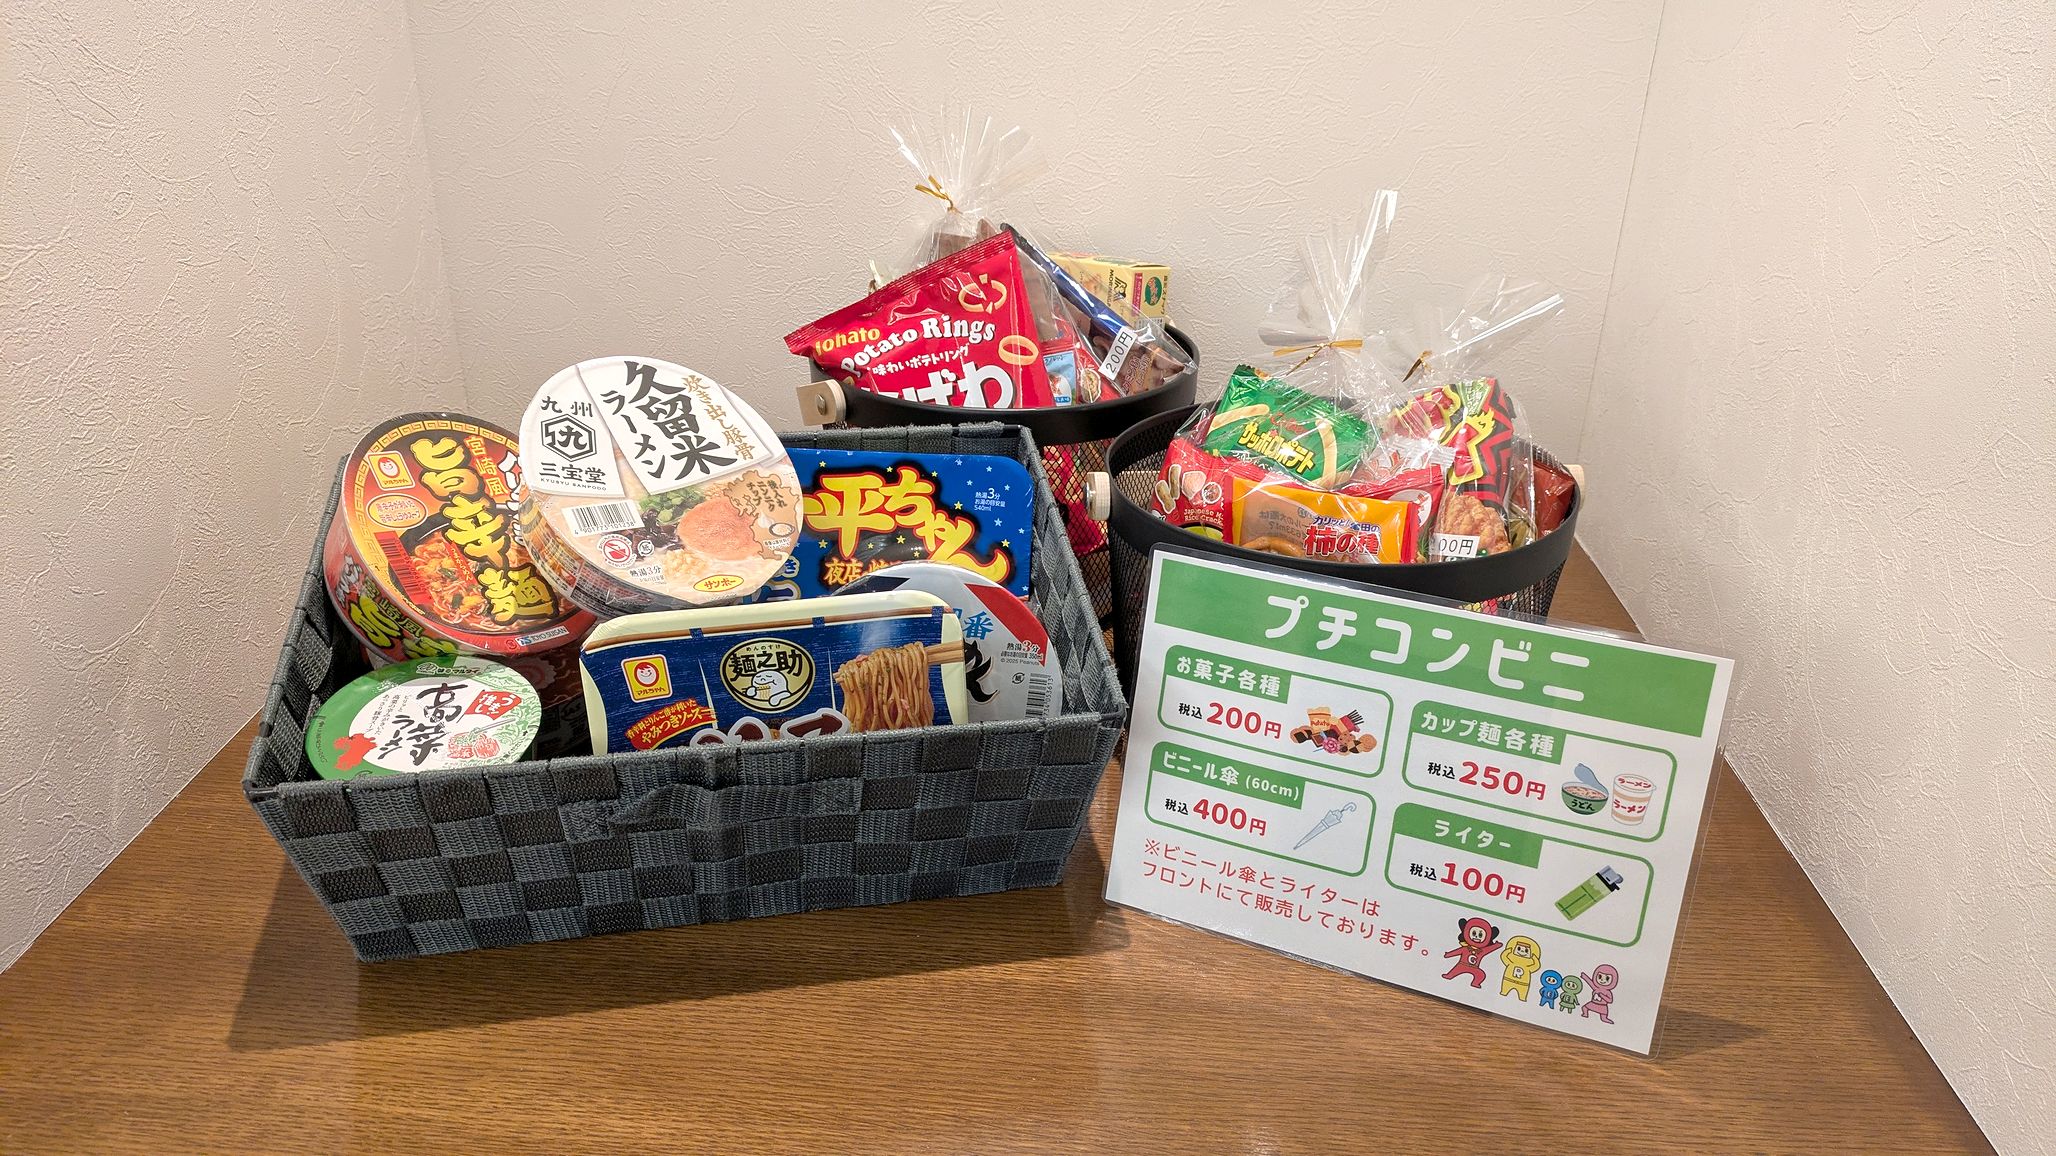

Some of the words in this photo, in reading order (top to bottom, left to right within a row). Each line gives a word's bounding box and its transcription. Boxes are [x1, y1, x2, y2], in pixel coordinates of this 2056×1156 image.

[841, 328, 919, 378] Potato
[920, 314, 996, 345] Rings
[1105, 332, 1133, 374] 200円
[860, 361, 1015, 409] げわ
[541, 396, 594, 418] 九州
[624, 360, 738, 481] 久留米
[682, 374, 756, 461] 炊き出し豚骨
[600, 390, 666, 479] ラーメン
[466, 435, 508, 498] 宮崎風
[540, 461, 608, 486] 三宝堂
[540, 477, 570, 487] KYUSYU
[572, 482, 607, 491] SANPODO
[757, 481, 776, 512] ニンニク
[975, 487, 1001, 501] 熱湯3分
[1304, 525, 1380, 557] 柿の種
[703, 577, 737, 589] サンポー
[729, 649, 803, 682] 麺之助
[746, 644, 781, 652] めんのすけ
[1265, 595, 1590, 702] プチコンビニ
[636, 687, 666, 697] マルちゃん
[1176, 656, 1281, 698] お菓子各種
[641, 707, 703, 744] やみつきソース
[1178, 702, 1203, 720] 税込
[1206, 702, 1283, 740] 200円
[1420, 711, 1555, 758] カップ麺各種
[1163, 750, 1240, 787] ビニール傘
[1245, 775, 1300, 801] (60cm)
[1427, 761, 1456, 781] 税込
[1459, 761, 1547, 802] 250円
[1617, 777, 1652, 789] ラーメン
[1165, 798, 1190, 816] 税込
[1193, 798, 1268, 837] 400円
[1571, 798, 1596, 812] うどん
[1613, 798, 1647, 814] ラーメン
[1434, 819, 1512, 850] ライター
[1409, 862, 1438, 882] 税込
[1440, 862, 1527, 904] 100円
[1142, 860, 1430, 957] フロントにて販売しております。
[1512, 967, 1525, 979] R
